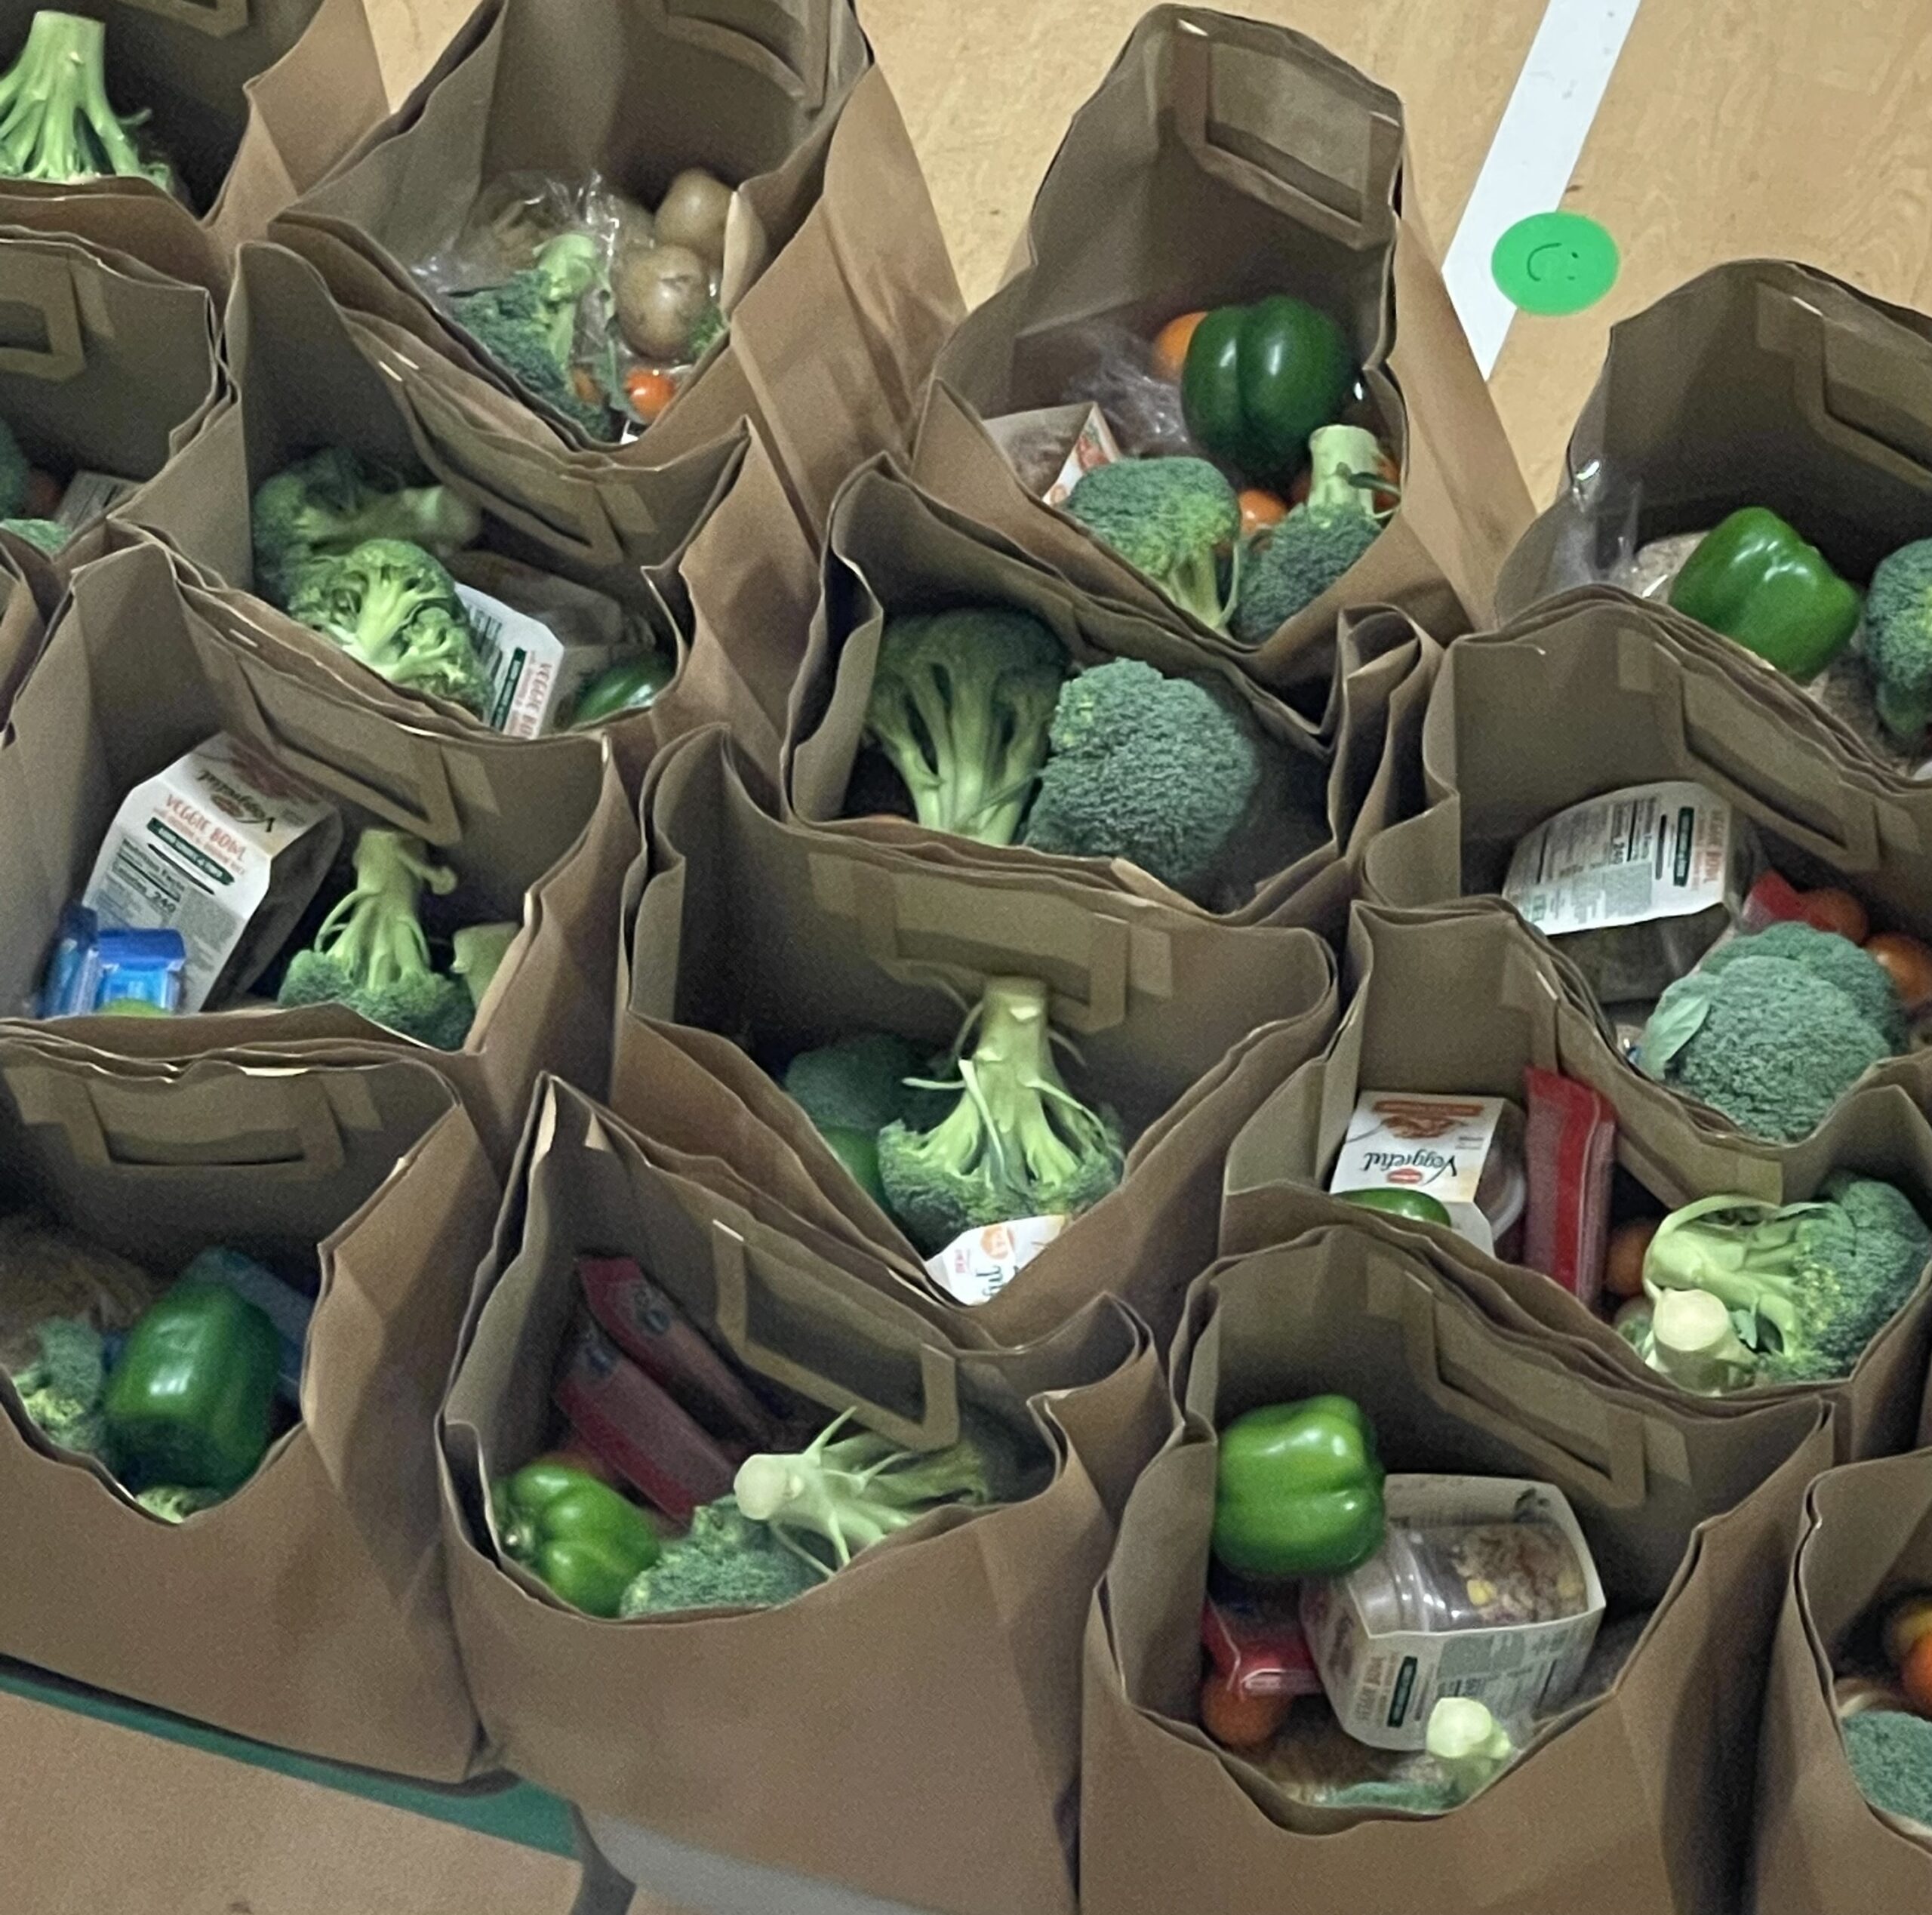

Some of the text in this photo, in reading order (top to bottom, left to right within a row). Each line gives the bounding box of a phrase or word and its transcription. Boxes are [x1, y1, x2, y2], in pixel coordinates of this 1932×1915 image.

[165, 793, 211, 835] VEGGIE
[209, 826, 247, 861] BOWL
[151, 891, 177, 913] 240
[1362, 1148, 1457, 1185] Veggieful
